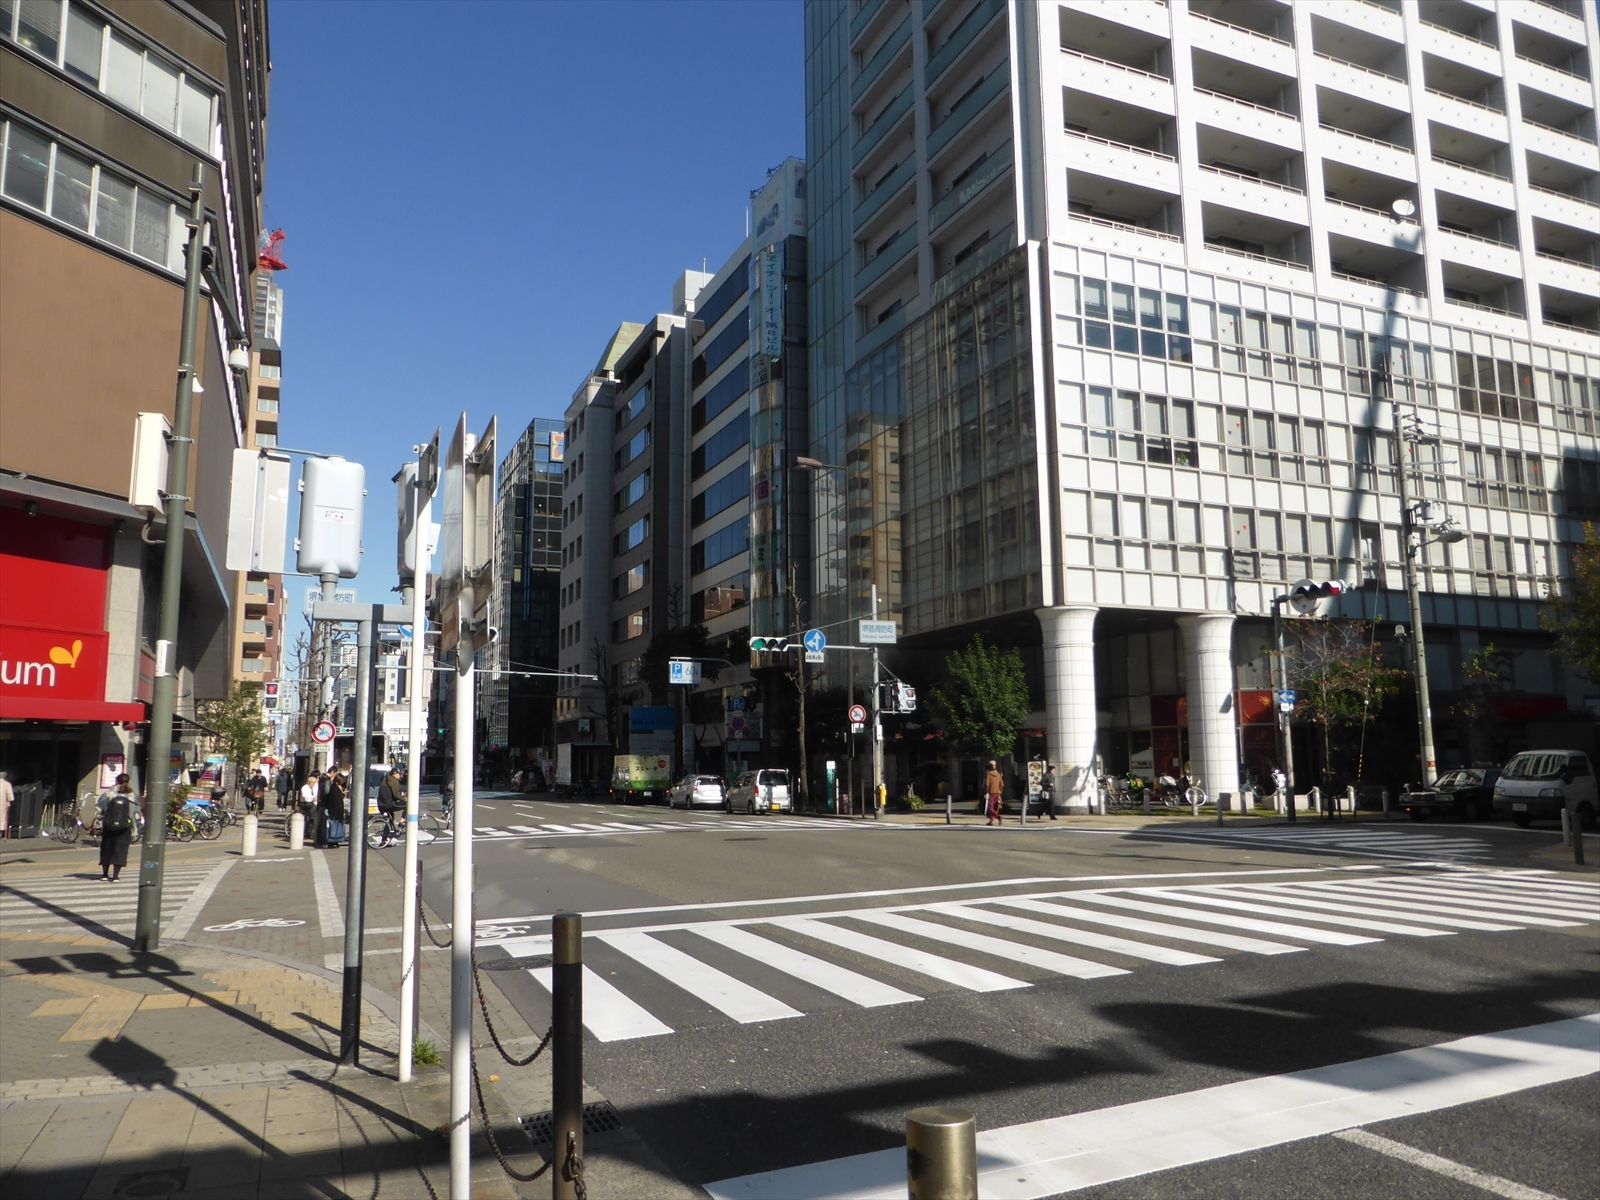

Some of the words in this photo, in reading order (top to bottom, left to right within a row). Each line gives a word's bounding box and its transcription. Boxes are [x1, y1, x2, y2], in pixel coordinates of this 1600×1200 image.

[308, 592, 353, 604] 堺防町
[1, 660, 56, 687] um
[674, 663, 681, 674] P
